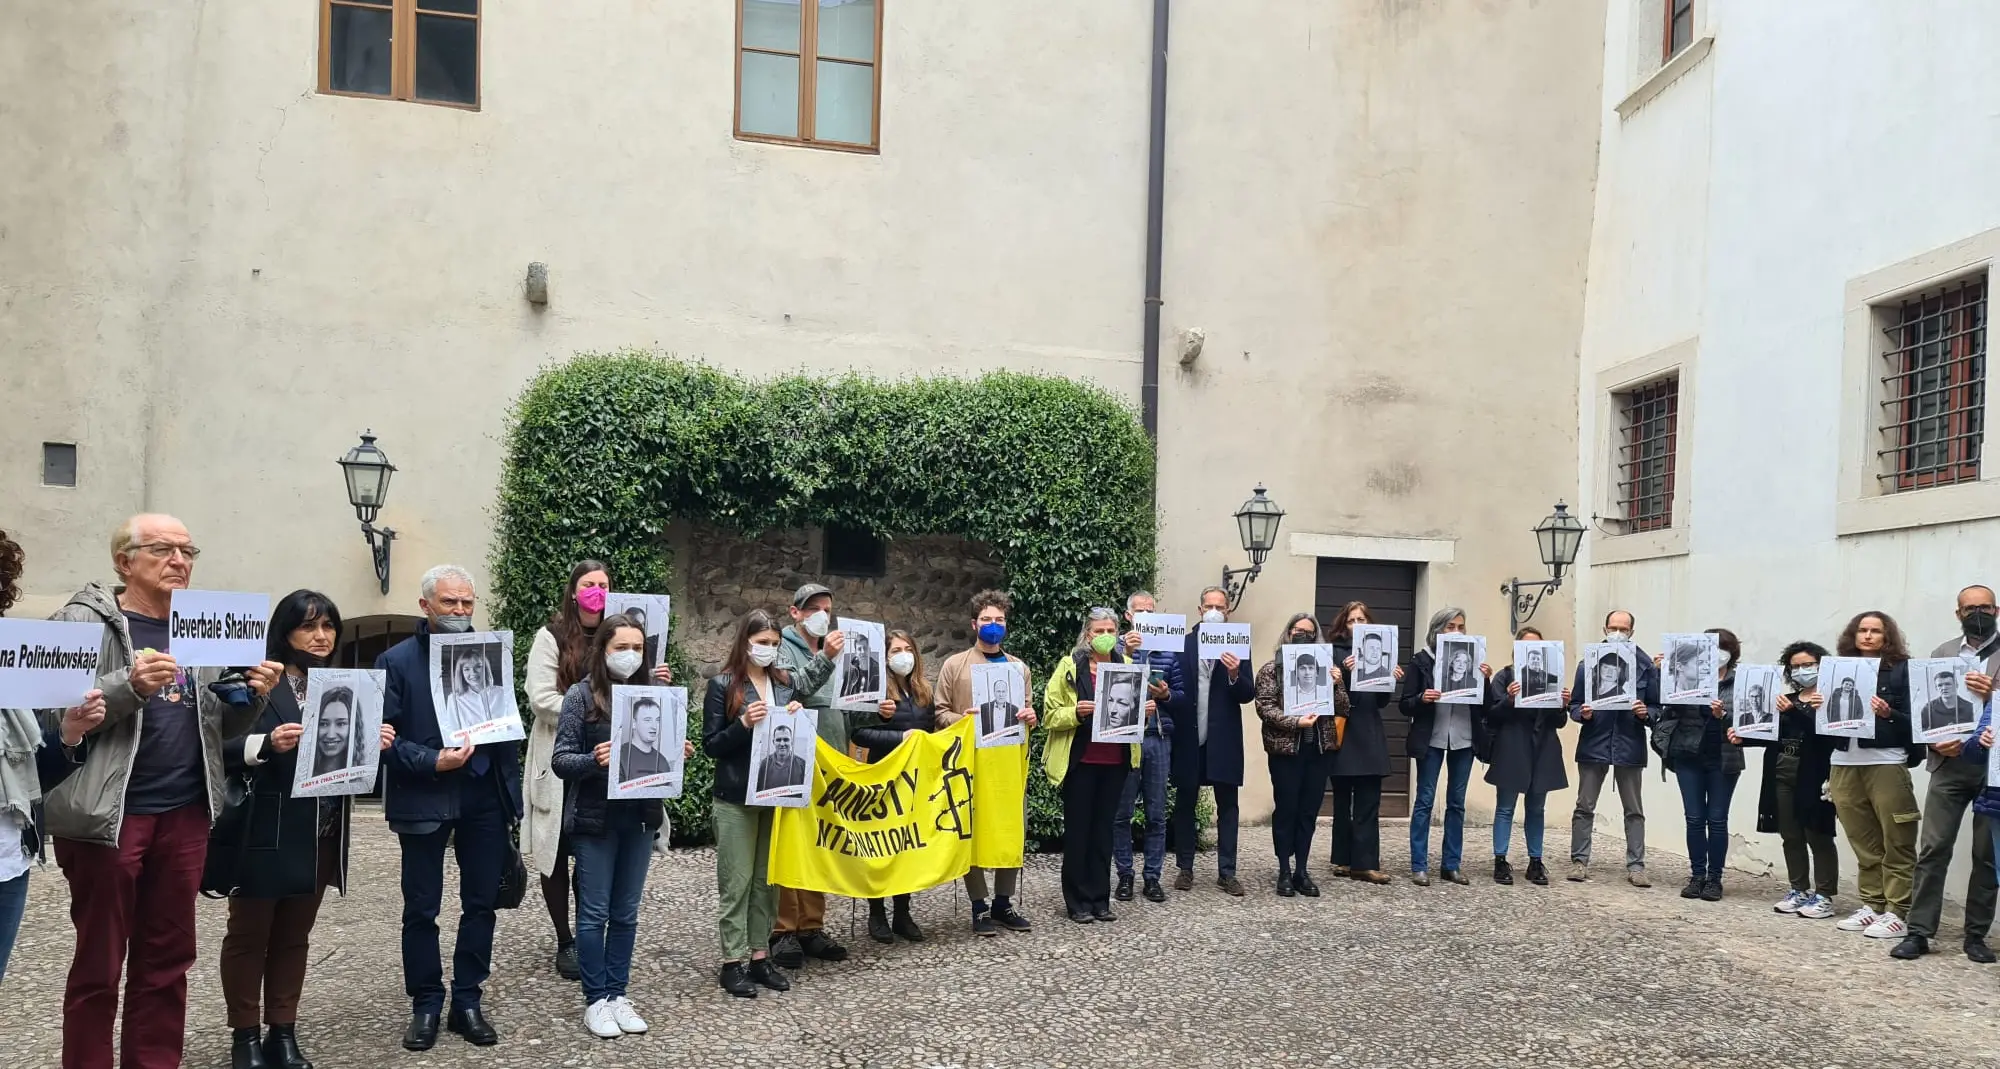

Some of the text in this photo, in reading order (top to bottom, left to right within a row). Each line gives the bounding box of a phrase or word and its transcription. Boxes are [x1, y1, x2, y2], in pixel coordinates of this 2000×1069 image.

[172, 611, 266, 640] Deverbale Shakirov
[1136, 623, 1185, 636] Maksym Levin
[1201, 632, 1249, 645] Oksana Baulina
[18, 644, 98, 675] Politotkovskaja
[817, 768, 918, 822] AMNESTY
[816, 818, 927, 858] NTERNATIONAL
